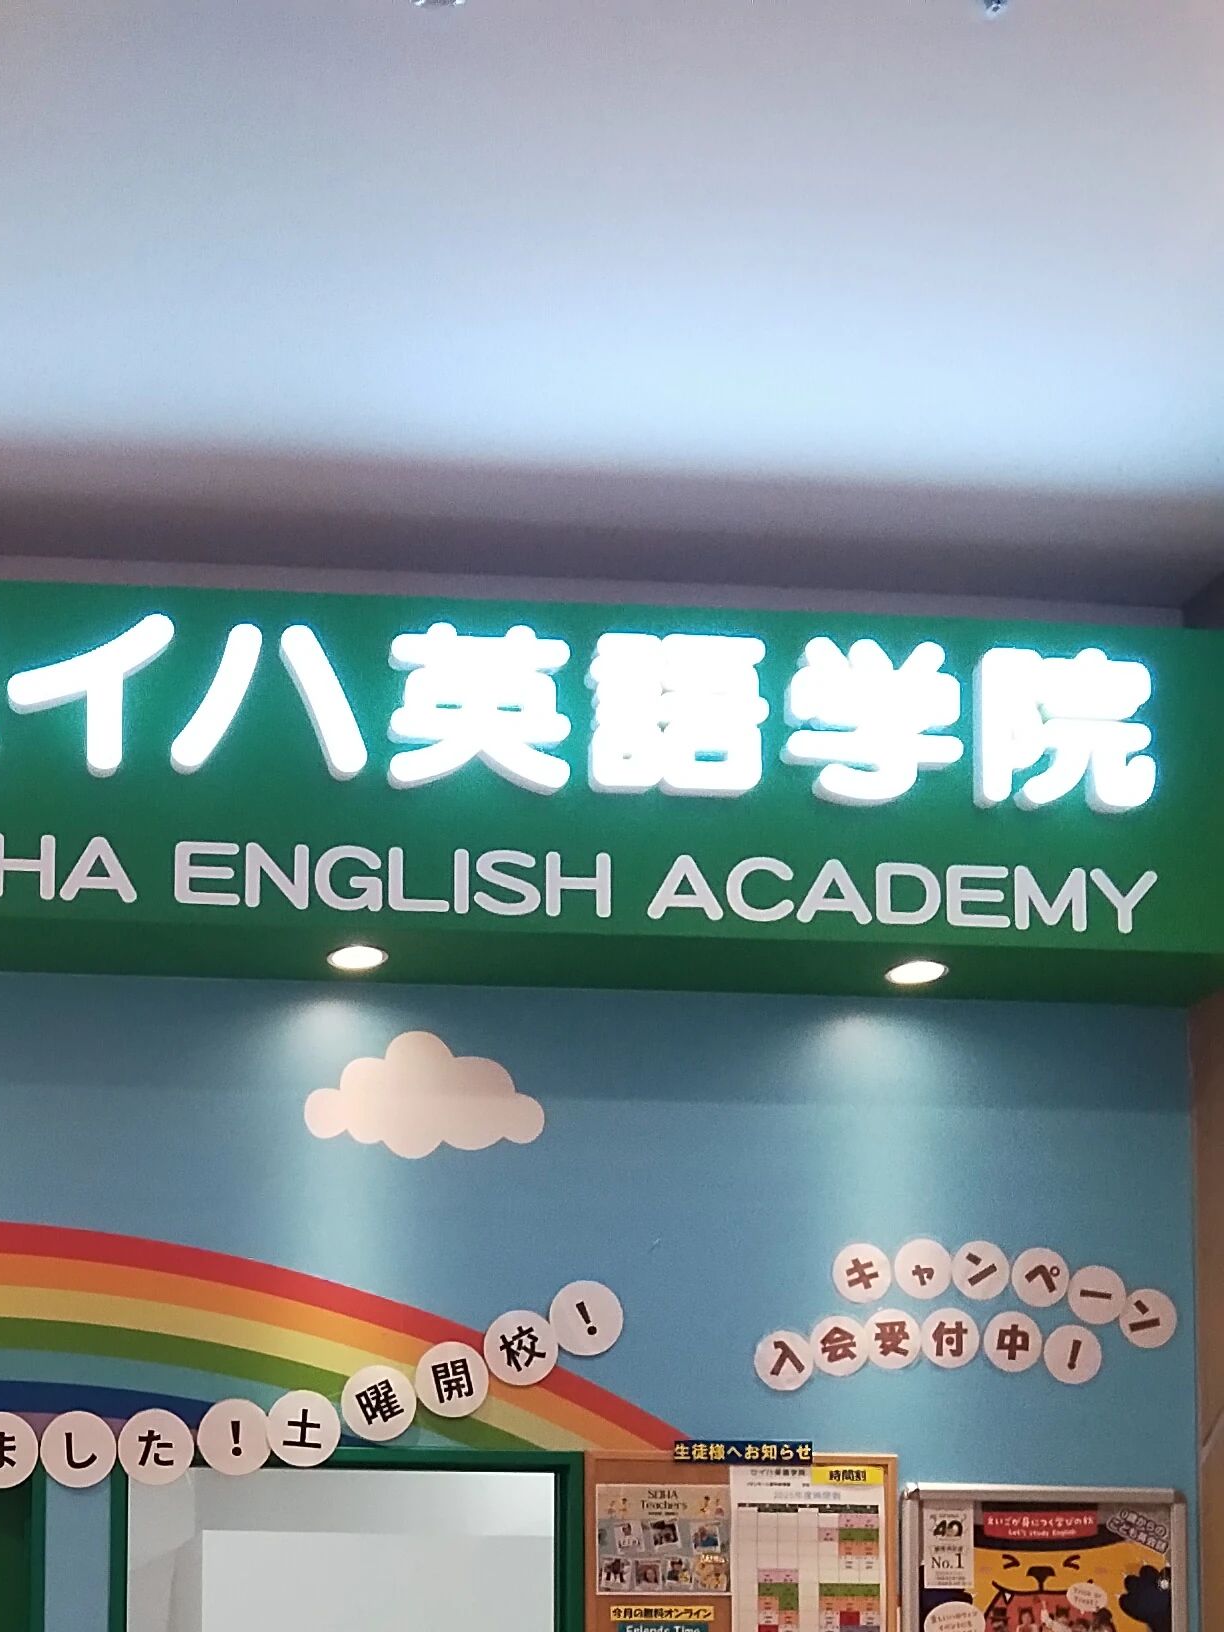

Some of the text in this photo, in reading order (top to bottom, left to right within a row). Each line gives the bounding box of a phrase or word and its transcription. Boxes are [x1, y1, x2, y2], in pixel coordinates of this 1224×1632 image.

[175, 841, 613, 918] ENGLISH
[646, 854, 1158, 933] ACADEMY
[845, 1252, 1161, 1333] キャンペーン
[674, 1443, 812, 1460] 生徒様へお知らせ
[829, 1469, 867, 1482] 時間割
[931, 1552, 965, 1570] No.1
[612, 1607, 712, 1620] 今月の無料オンライン
